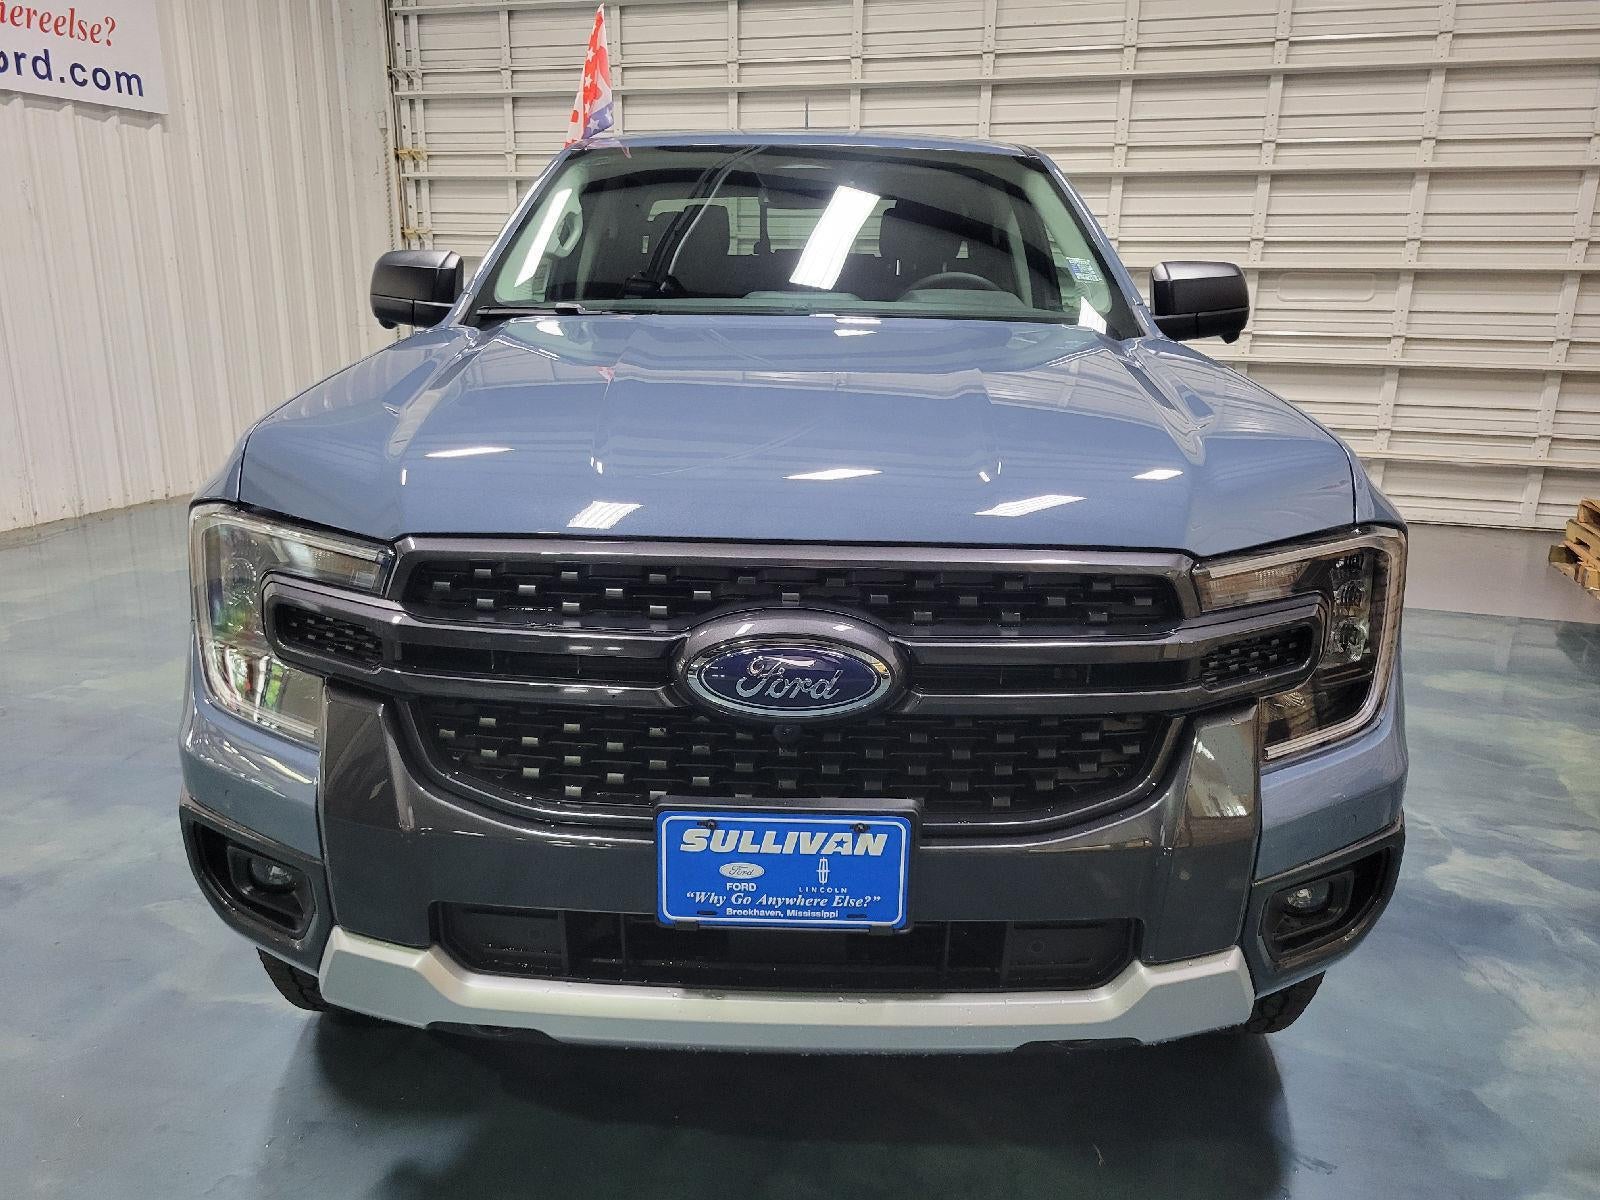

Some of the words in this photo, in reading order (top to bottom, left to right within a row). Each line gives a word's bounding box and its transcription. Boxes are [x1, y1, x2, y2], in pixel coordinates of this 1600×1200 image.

[735, 655, 844, 700] Ford
[680, 828, 888, 856] SULLIVAN
[728, 865, 755, 876] Ford
[726, 882, 757, 892] FORD
[798, 886, 848, 894] LINCOLN
[686, 891, 727, 907] “Why
[731, 893, 752, 905] Go
[755, 893, 828, 908] Anywhere
[831, 895, 881, 907] Else?”
[726, 907, 784, 918] Brookhaven,
[786, 909, 839, 919] Mississippi
